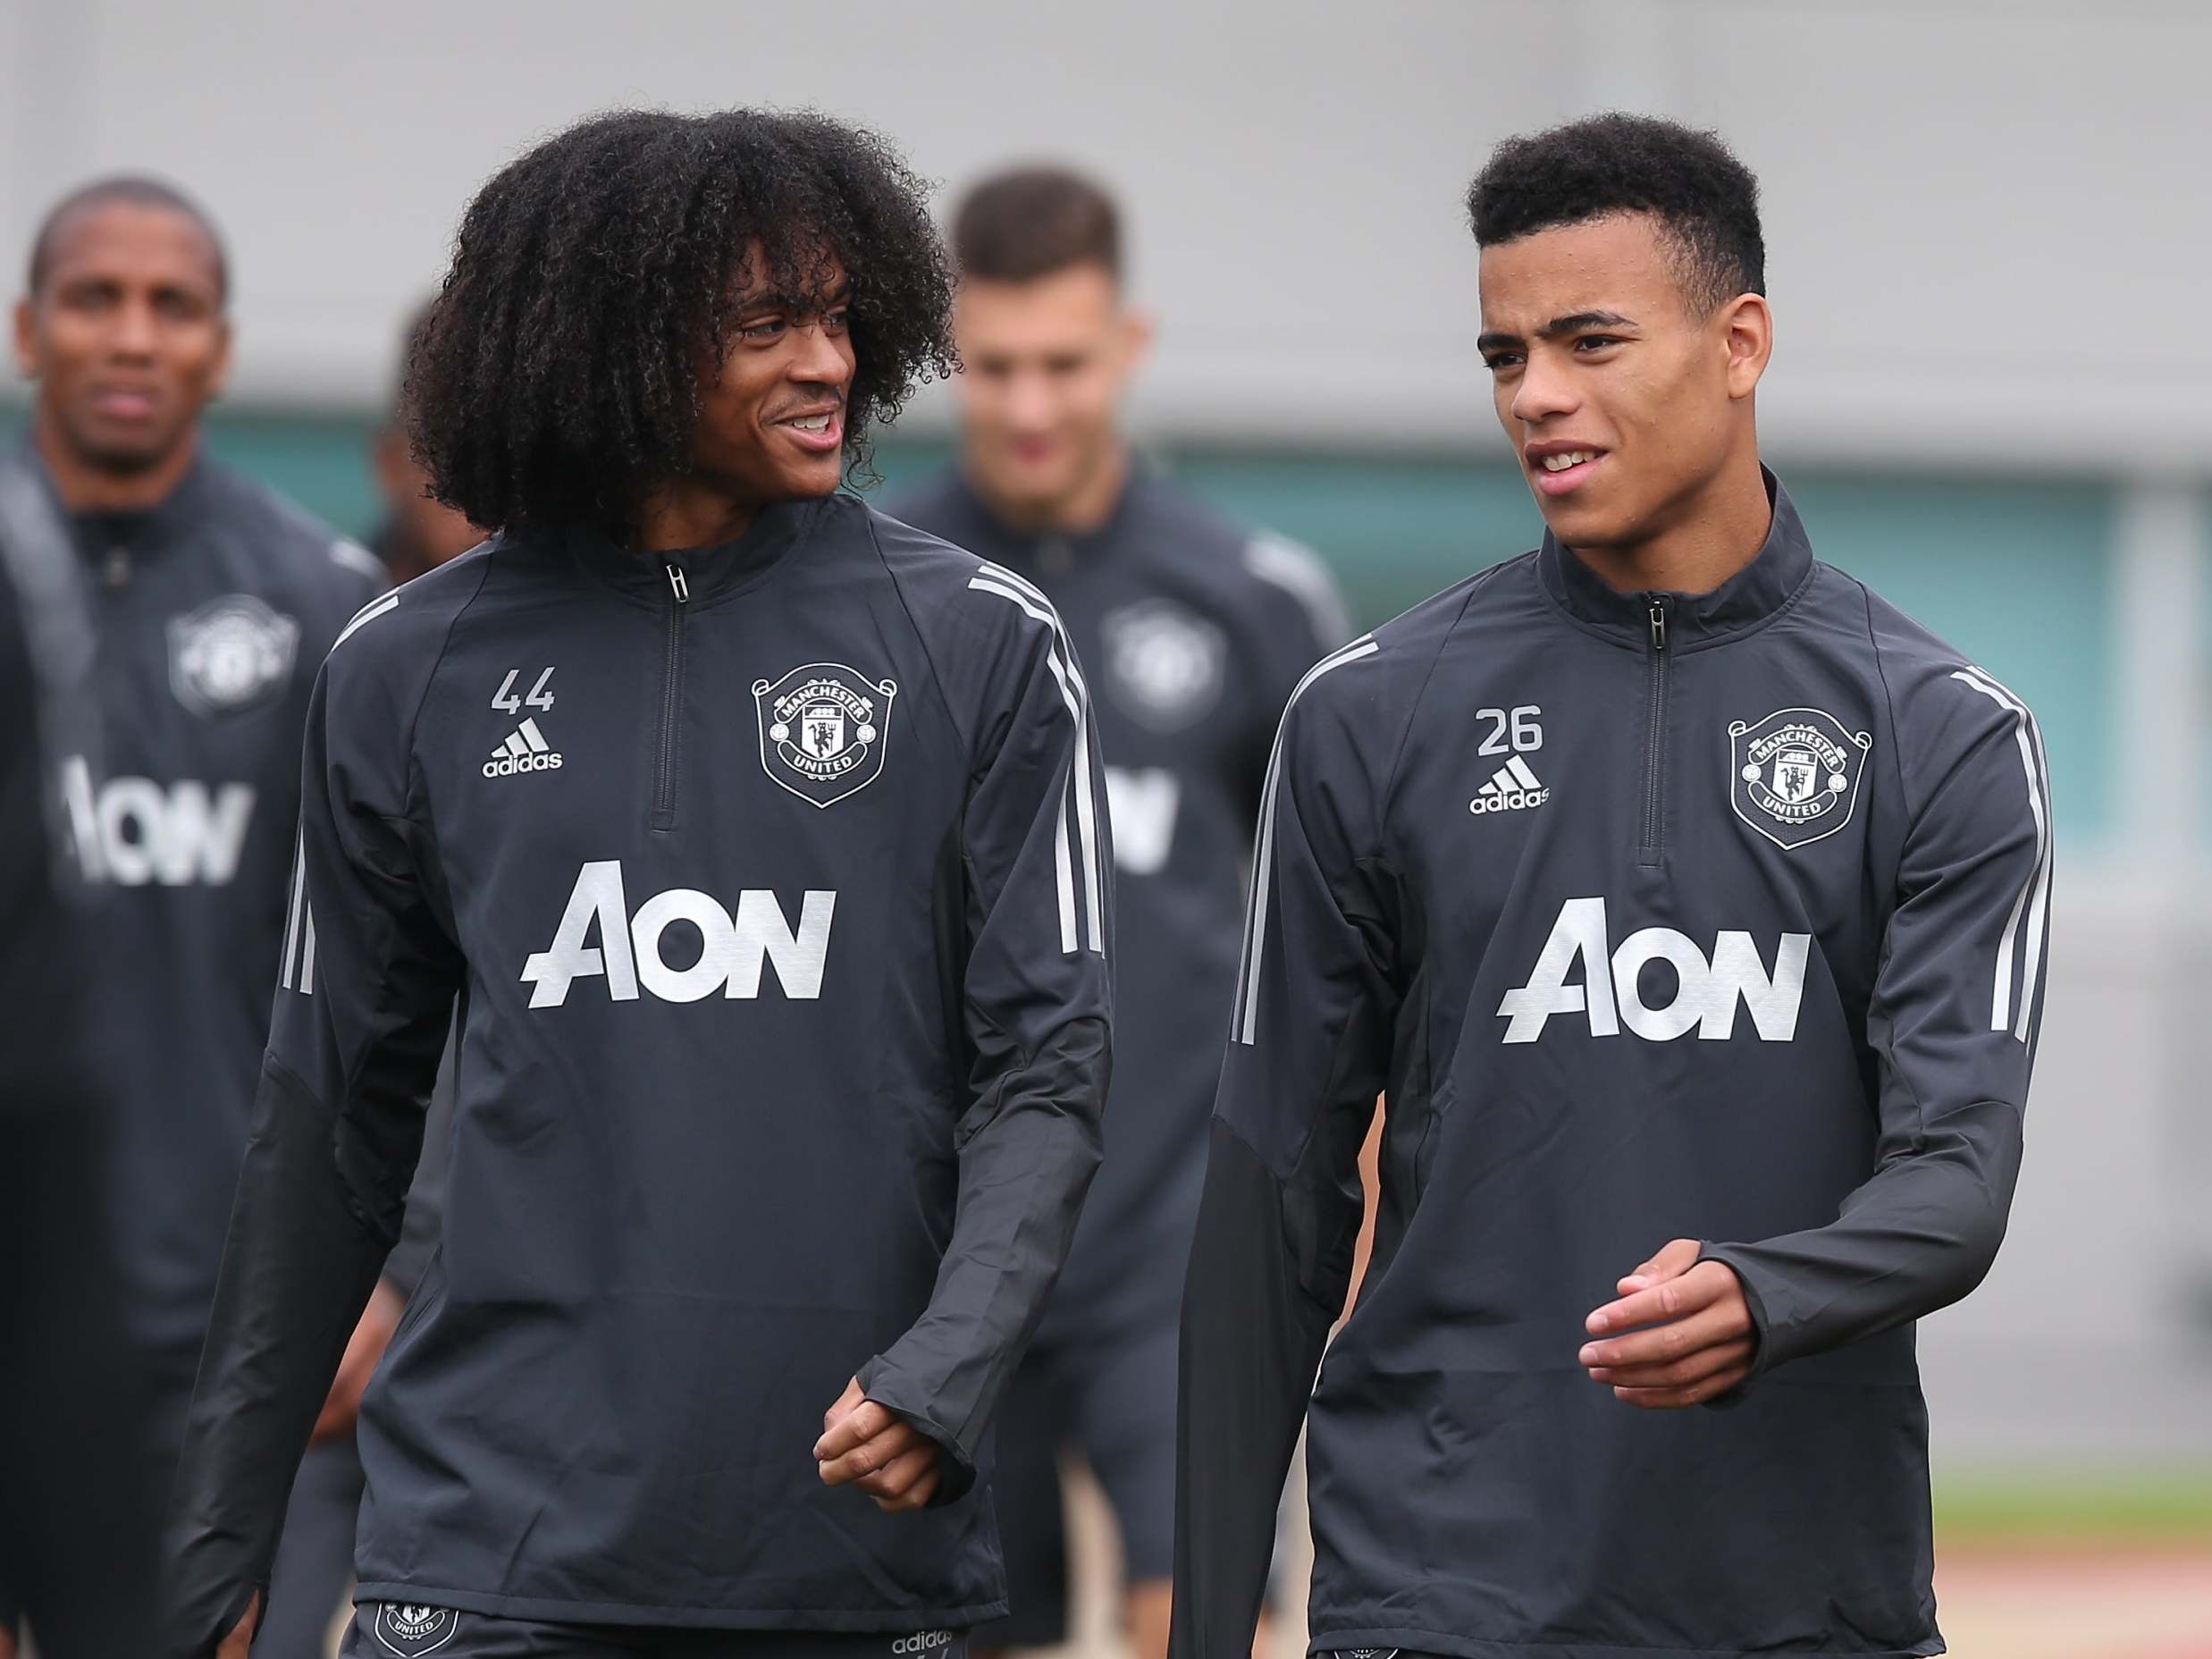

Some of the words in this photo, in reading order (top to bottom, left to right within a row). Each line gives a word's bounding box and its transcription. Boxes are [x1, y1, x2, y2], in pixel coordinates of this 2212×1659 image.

[492, 667, 555, 715] 44
[780, 686, 866, 720] MANCHESTER
[1475, 704, 1543, 757] 26
[483, 753, 562, 778] adidas
[794, 755, 852, 773] UNITED
[1756, 731, 1838, 767] MANCHESTER
[1469, 787, 1551, 815] adidas
[1762, 796, 1821, 816] UNITED
[519, 860, 837, 1009] AON
[1495, 897, 1812, 1044] AON
[395, 1621, 433, 1634] UNITED
